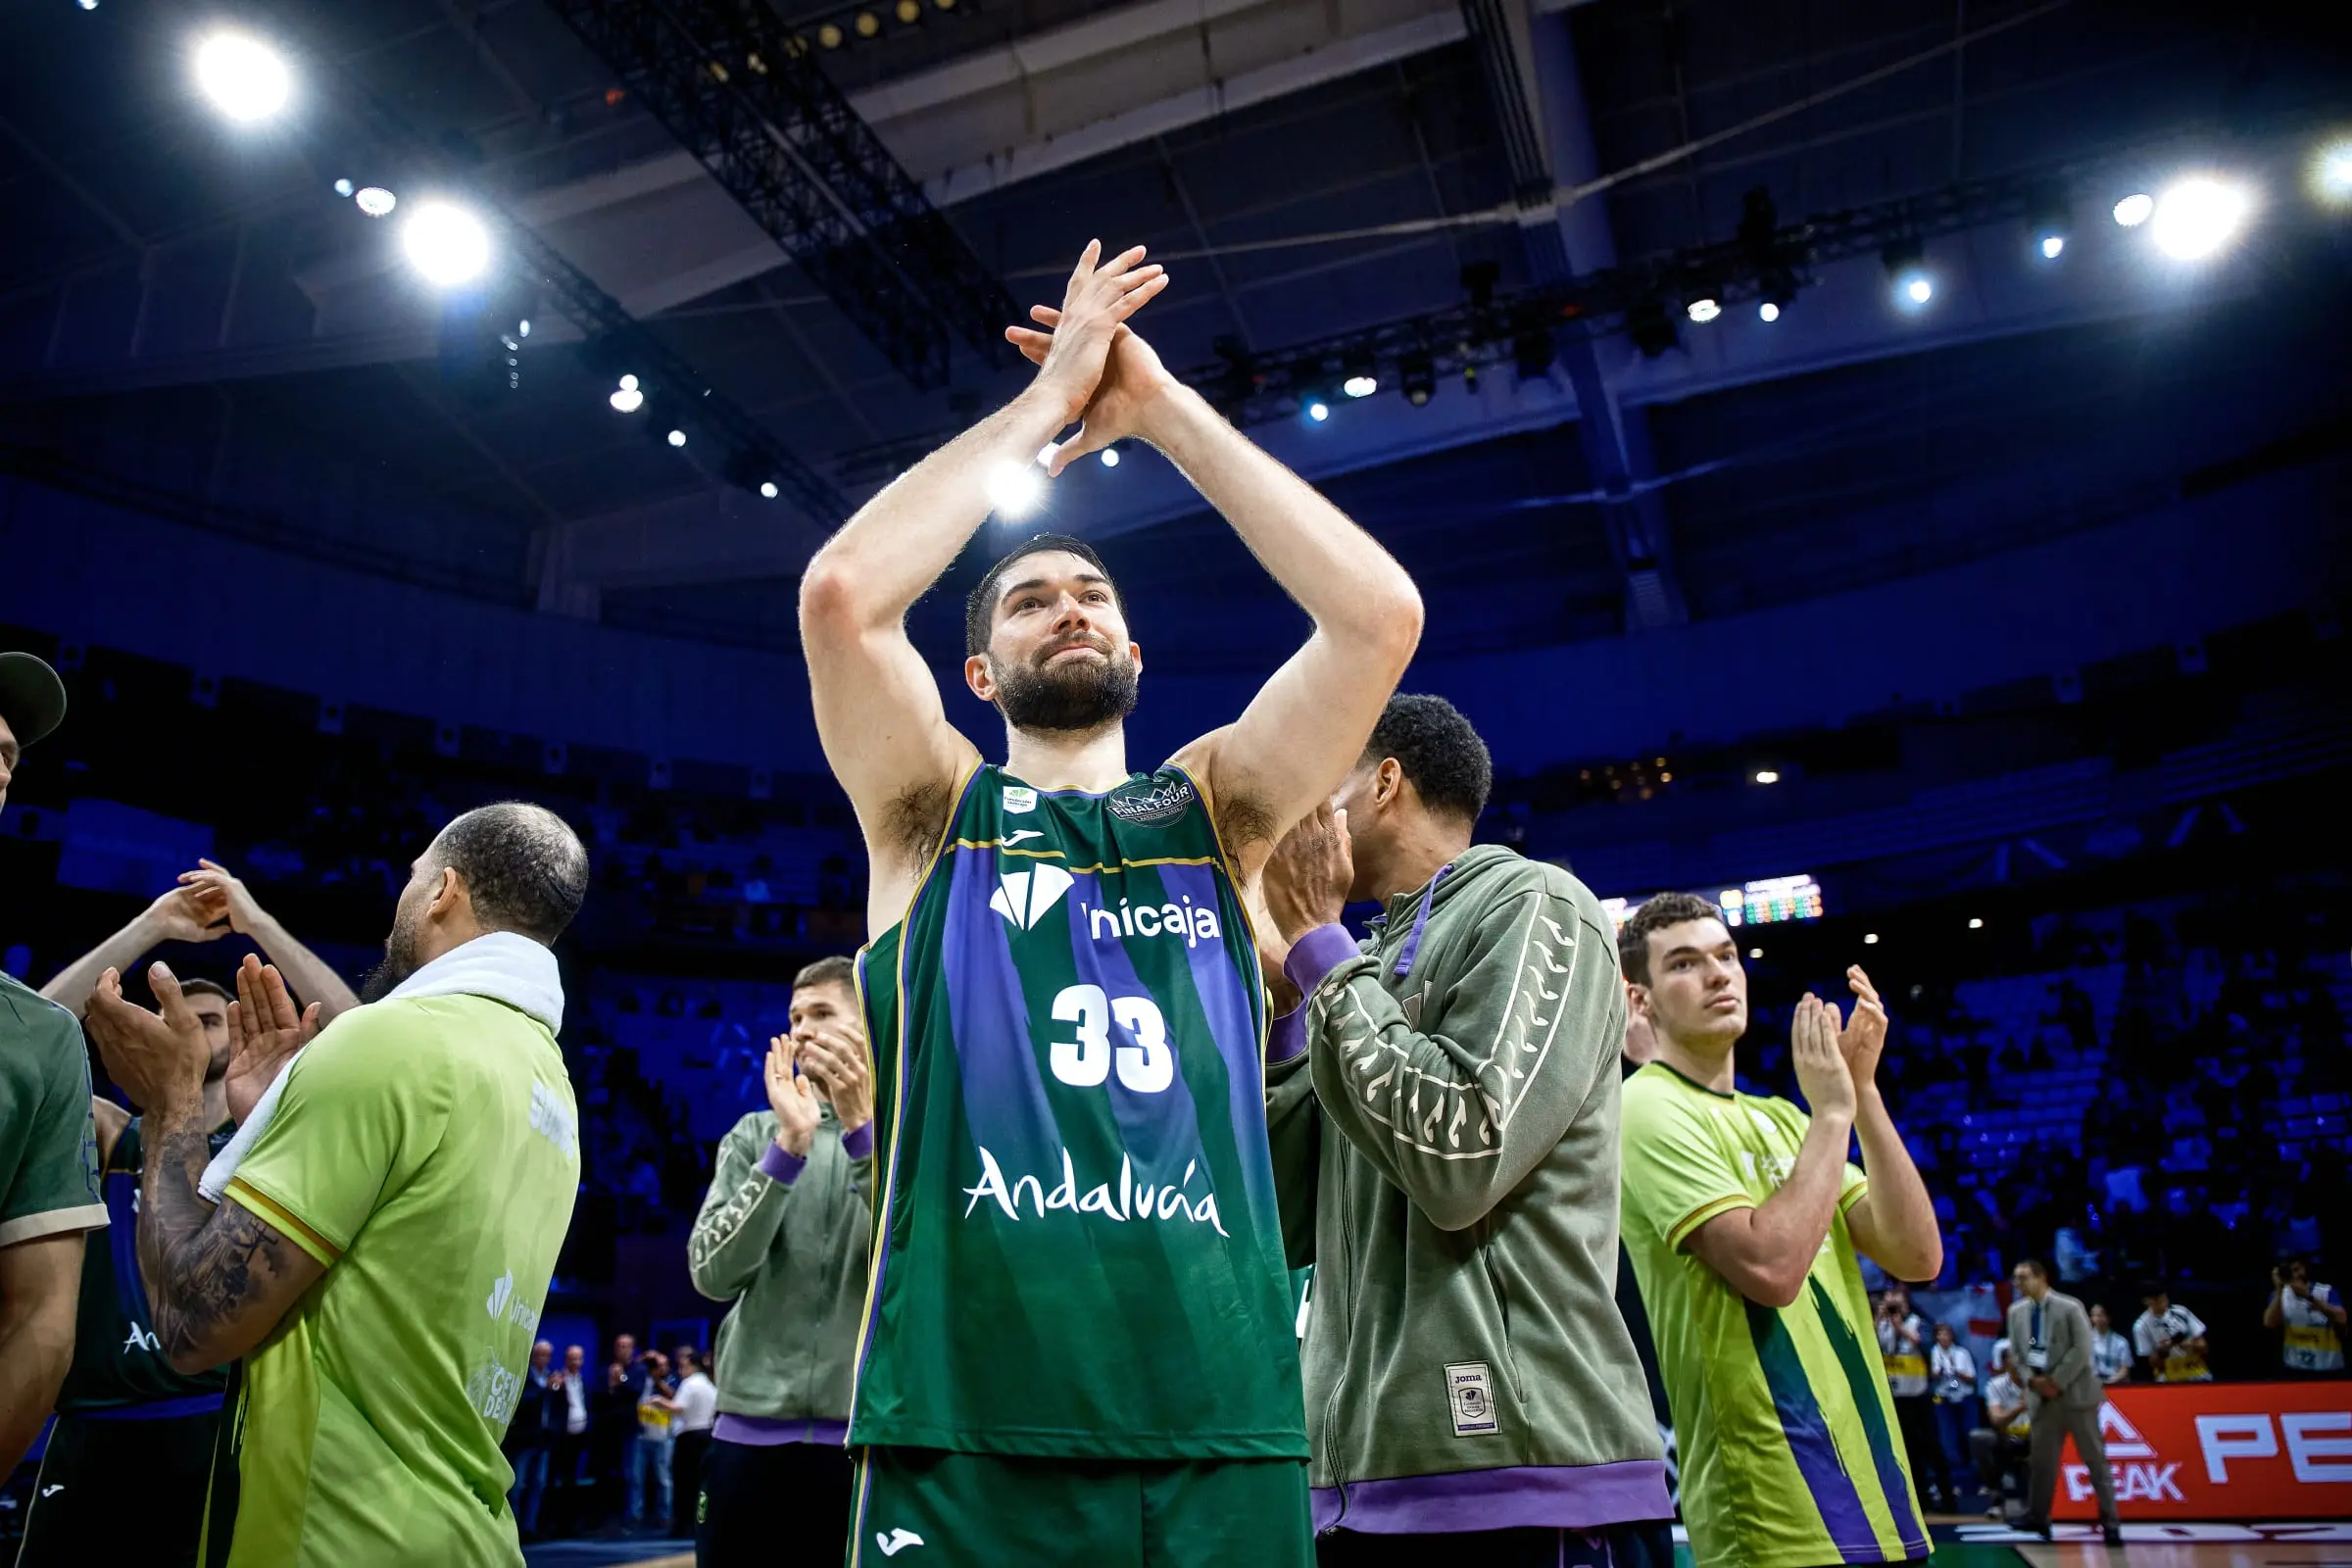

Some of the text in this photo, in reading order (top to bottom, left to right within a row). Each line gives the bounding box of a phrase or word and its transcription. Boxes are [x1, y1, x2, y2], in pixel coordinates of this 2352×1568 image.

[1111, 804, 1154, 815] FINAL
[1153, 786, 1190, 809] FOUR
[1050, 983, 1174, 1094] 33
[962, 1145, 1231, 1239] Andalucía
